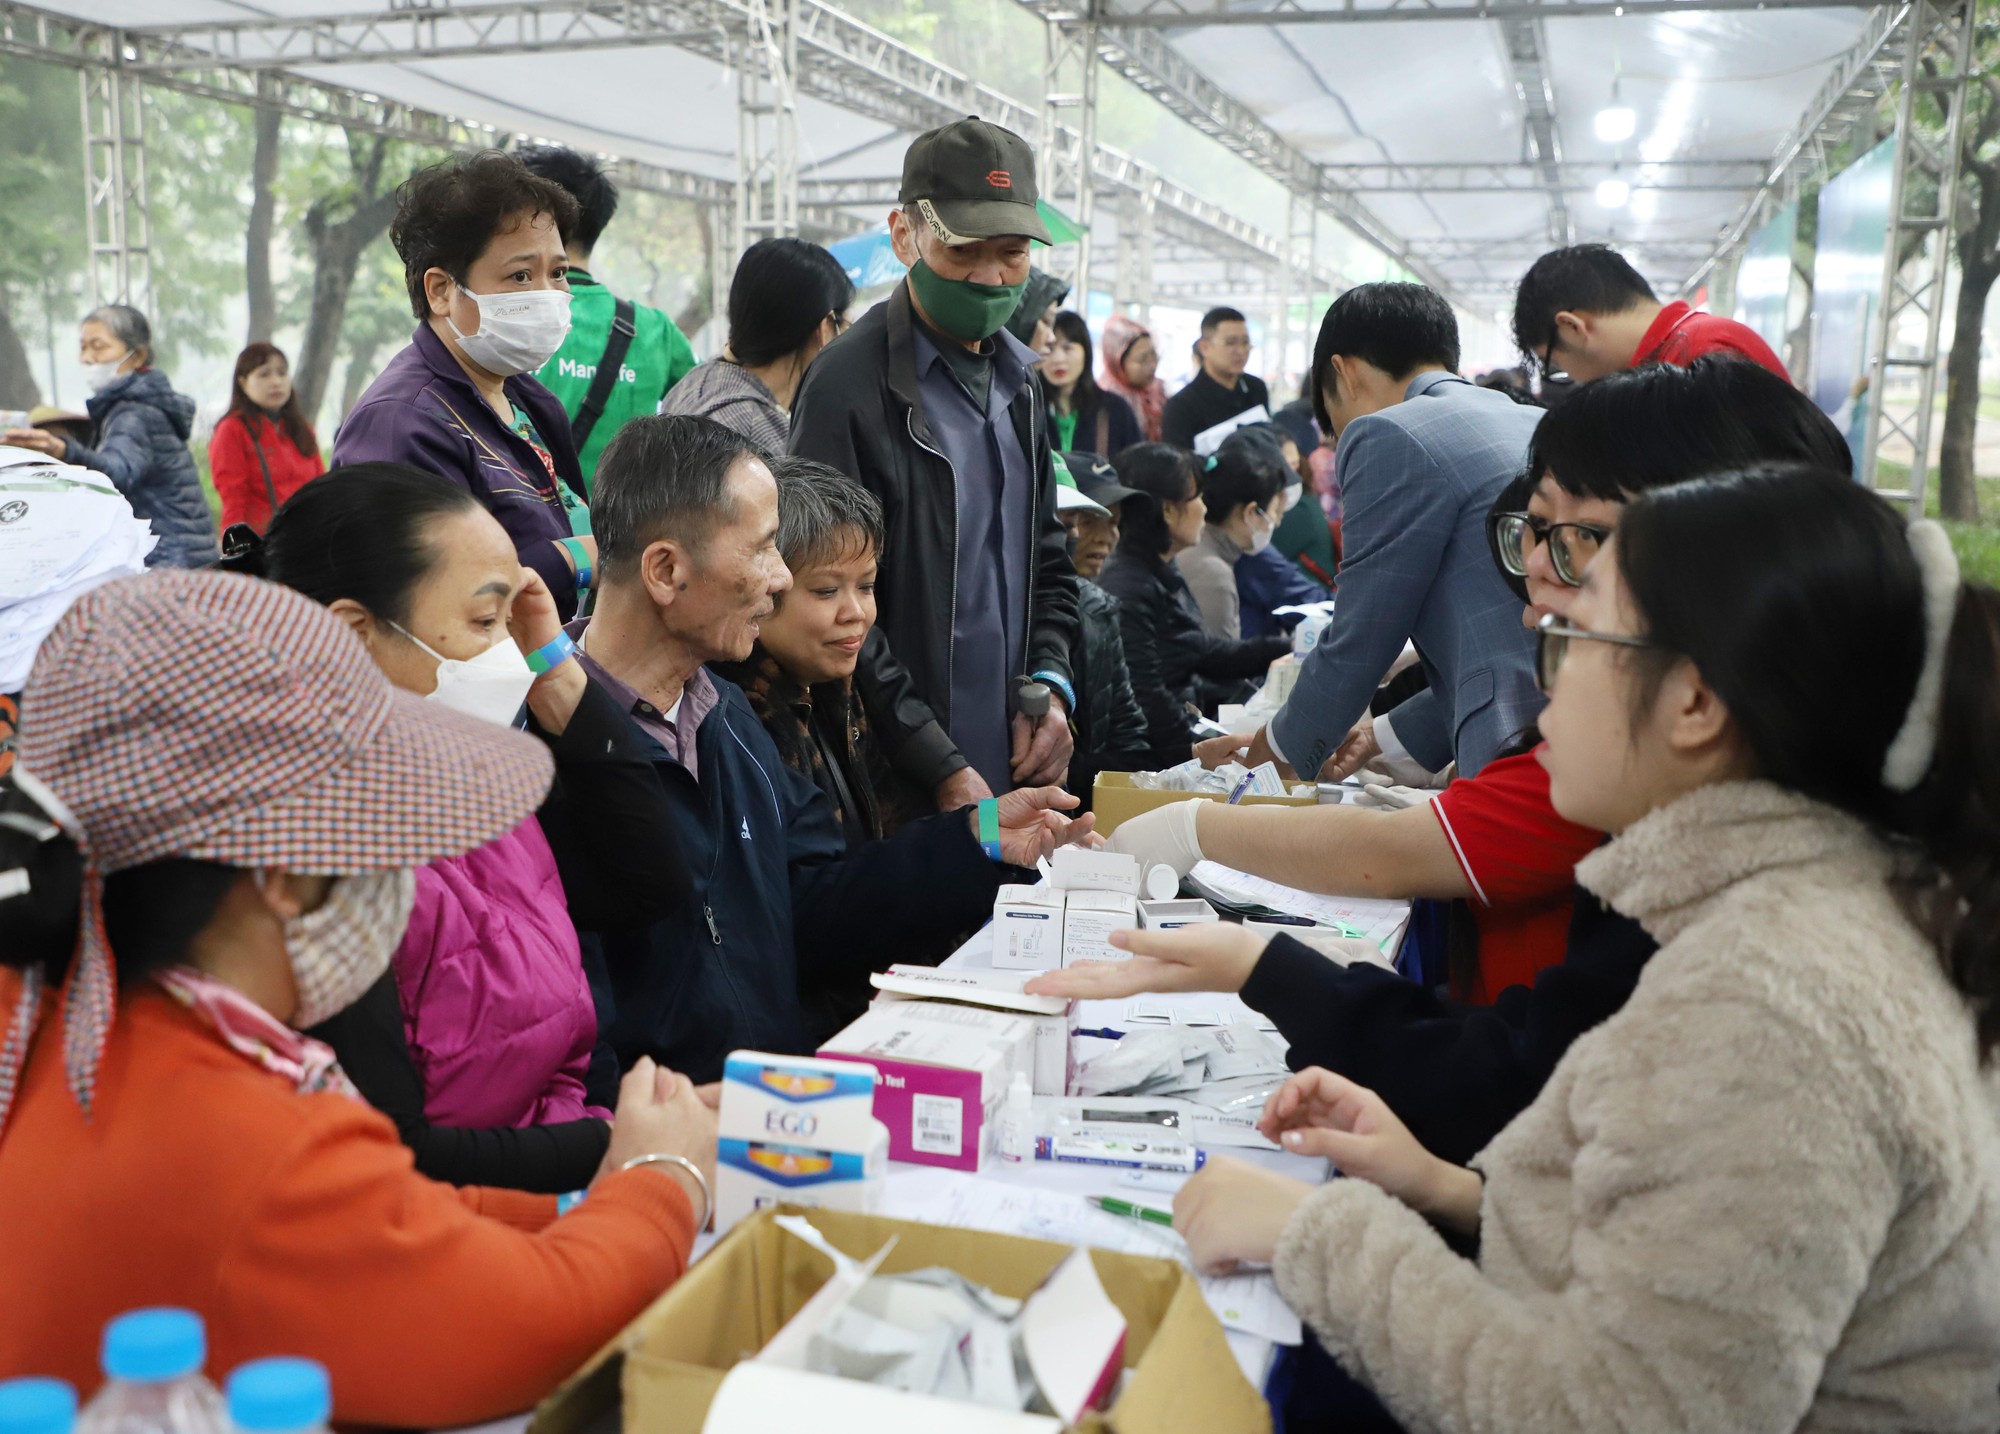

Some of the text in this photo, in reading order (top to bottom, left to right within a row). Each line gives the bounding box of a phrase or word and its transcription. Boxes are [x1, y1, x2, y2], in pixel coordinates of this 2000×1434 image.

[921, 201, 951, 242] GIOVANNI
[558, 357, 636, 383] Manfe
[885, 1074, 905, 1088] Test
